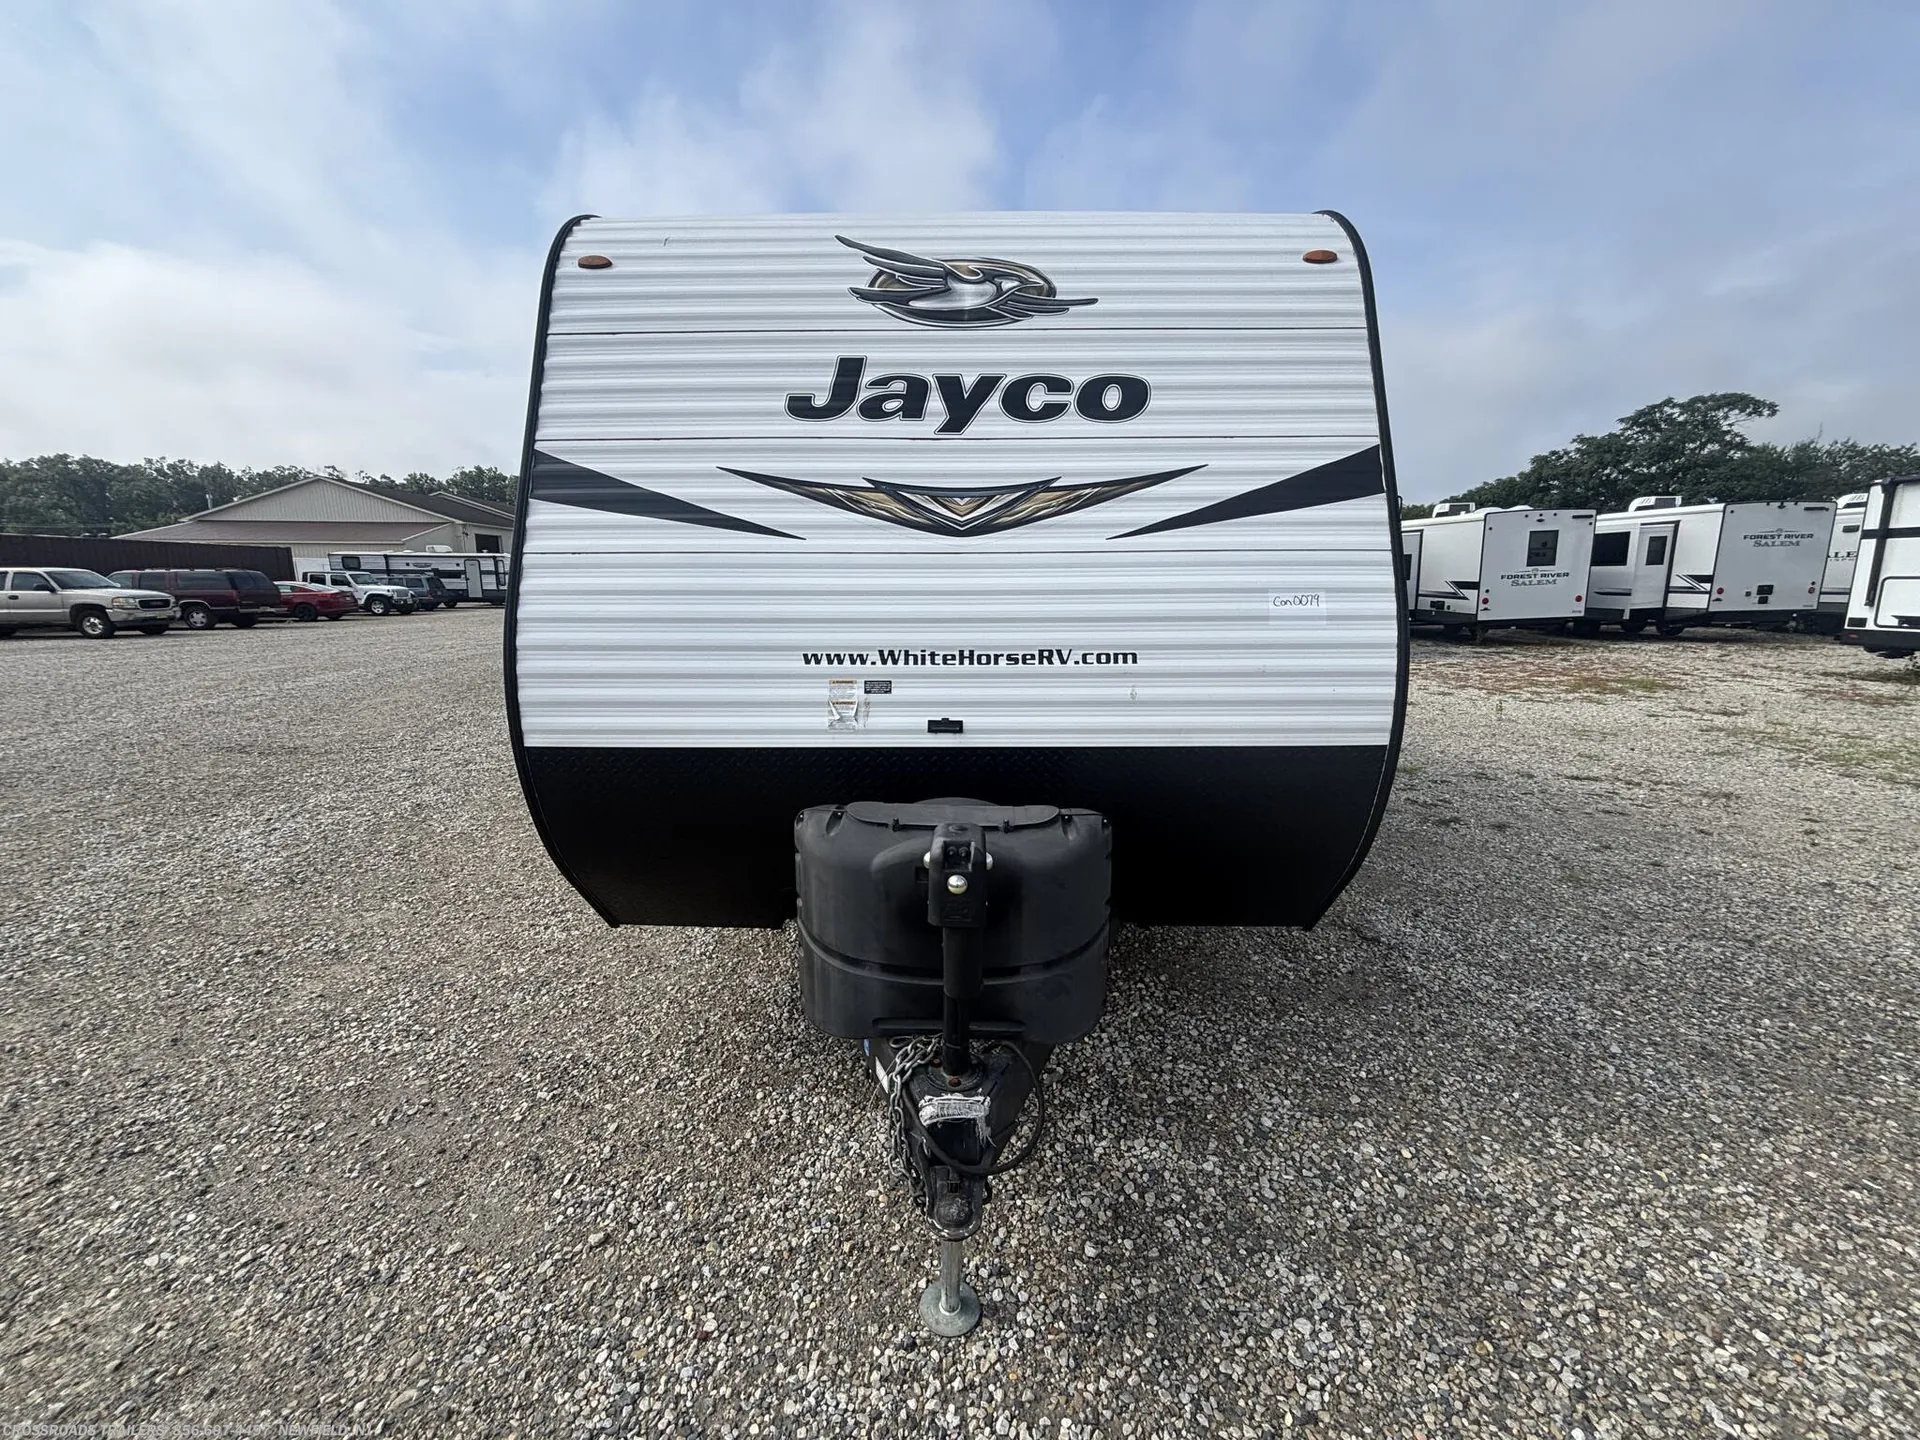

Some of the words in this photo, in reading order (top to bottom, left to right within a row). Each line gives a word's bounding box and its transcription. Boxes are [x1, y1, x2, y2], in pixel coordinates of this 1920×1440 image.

[784, 355, 1152, 436] Jayco
[1511, 579, 1557, 587] SALEM
[802, 648, 1138, 666] www.WhiteHorseRV.com
